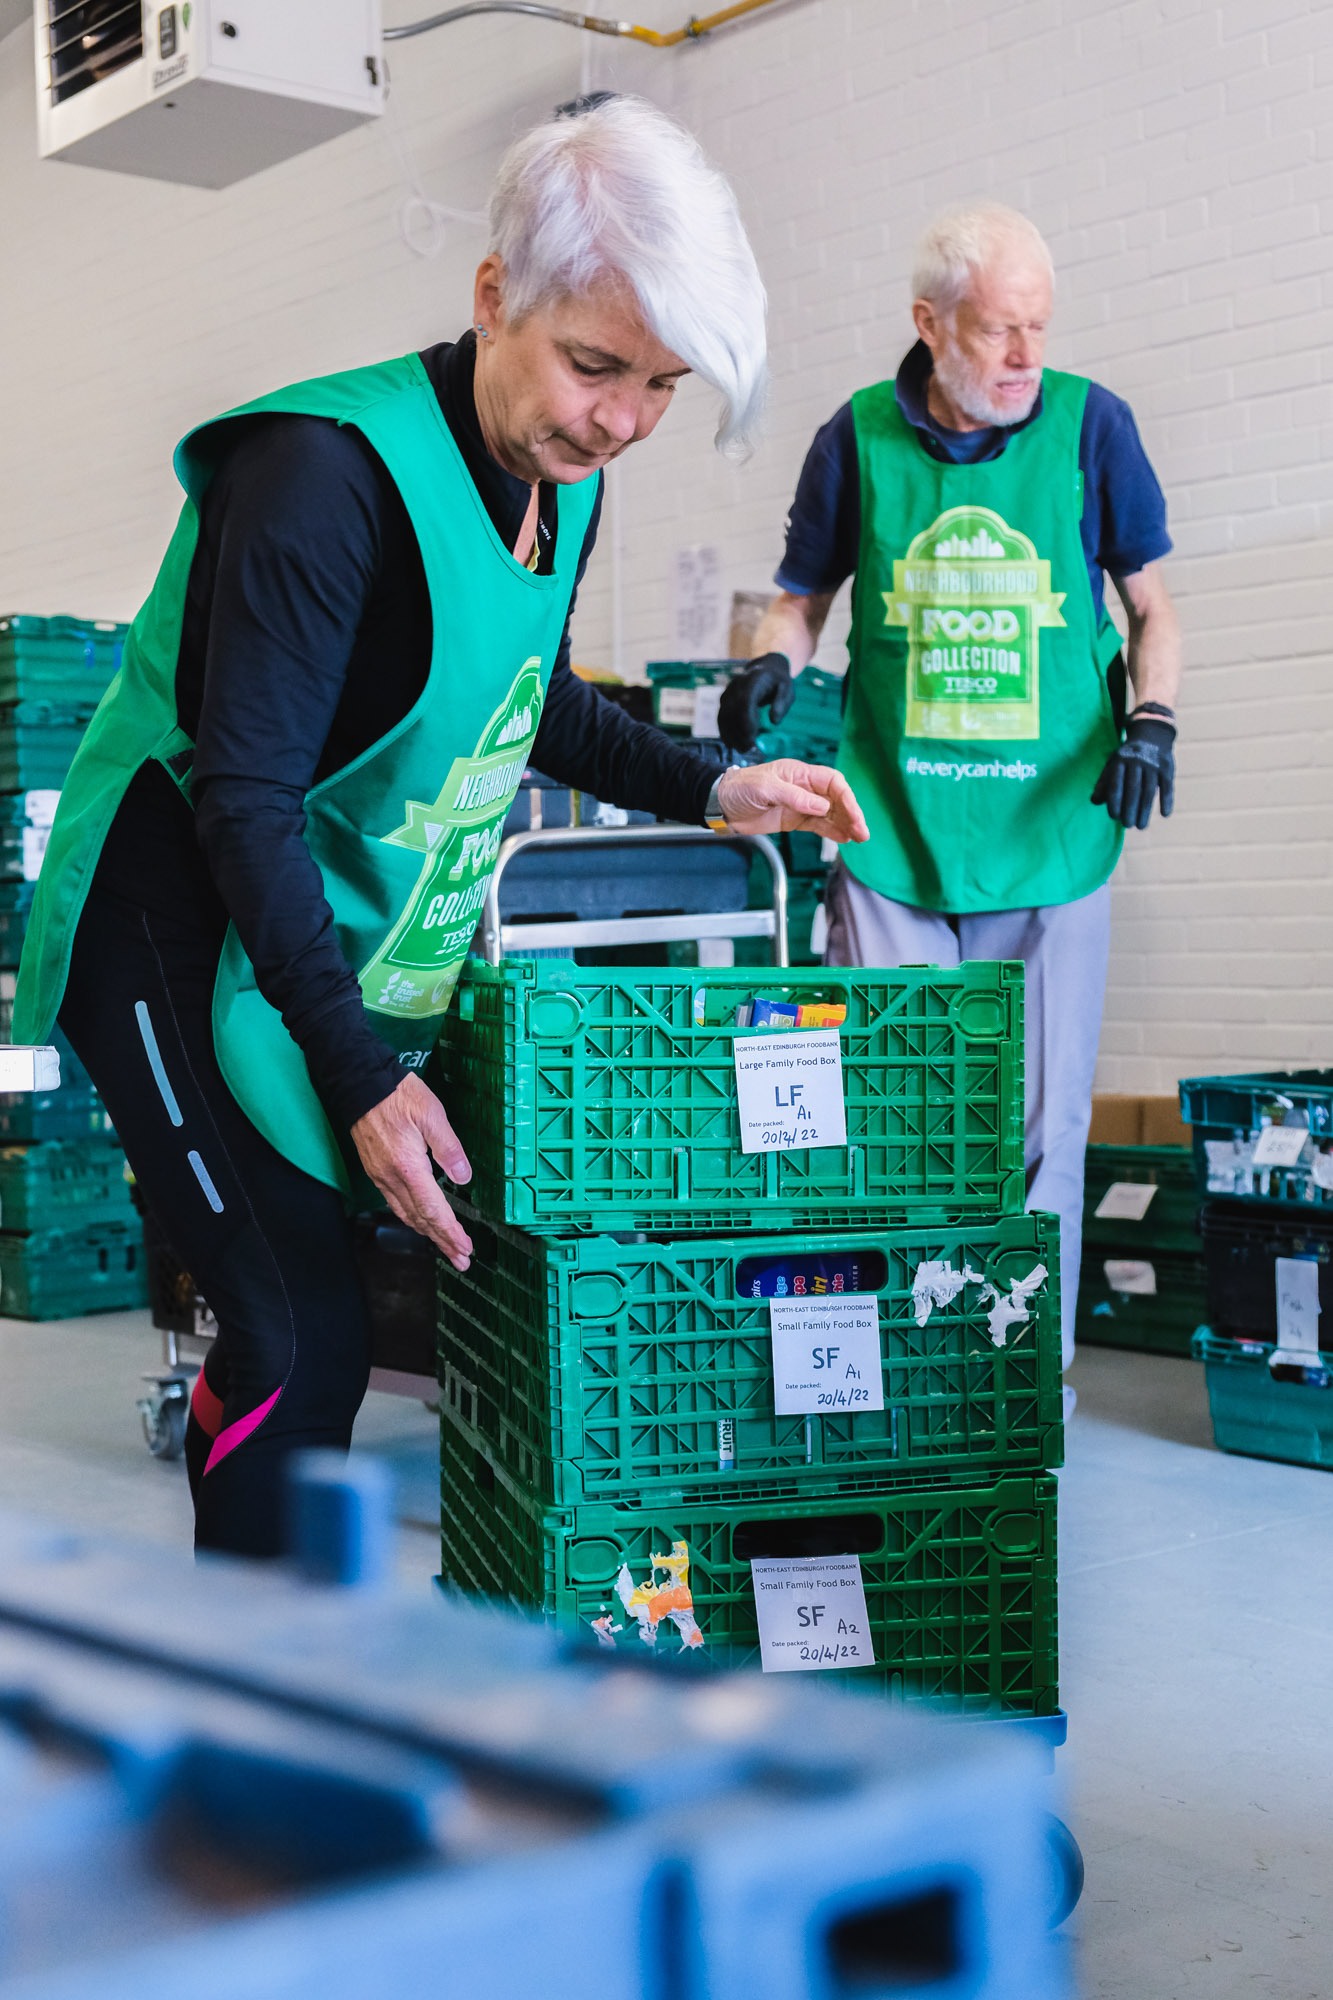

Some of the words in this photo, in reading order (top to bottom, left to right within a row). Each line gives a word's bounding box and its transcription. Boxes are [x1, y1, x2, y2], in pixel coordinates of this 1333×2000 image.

[904, 569, 1039, 594] NEIGHBOURHOOD
[922, 608, 1020, 640] FOOD
[921, 646, 1021, 676] COLLECTION
[943, 676, 998, 692] TESCO
[905, 756, 1038, 782] #everycanhelps
[400, 979, 416, 990] the
[736, 1044, 771, 1053] NORTH-EAST
[739, 1061, 764, 1071] Large
[766, 1059, 795, 1069] Family
[797, 1057, 818, 1066] Food
[820, 1057, 837, 1065] Box
[775, 1084, 804, 1107] LF
[762, 1120, 785, 1128] packed:
[751, 1279, 761, 1298] airs
[777, 1322, 801, 1331] Small
[803, 1321, 831, 1331] Family
[833, 1320, 854, 1329] Food
[856, 1320, 872, 1328] Box
[812, 1346, 840, 1369] SF
[800, 1382, 822, 1390] packed:
[817, 1387, 869, 1407] 20/4/22
[792, 1565, 825, 1573] EDINBURGH
[826, 1563, 857, 1571] FOODBANK
[760, 1582, 784, 1590] Small
[786, 1580, 814, 1590] Family
[816, 1579, 838, 1588] Food
[840, 1579, 857, 1587] Box
[797, 1605, 826, 1627] SF
[837, 1617, 860, 1635] A2
[799, 1643, 860, 1663] 20/4/22
